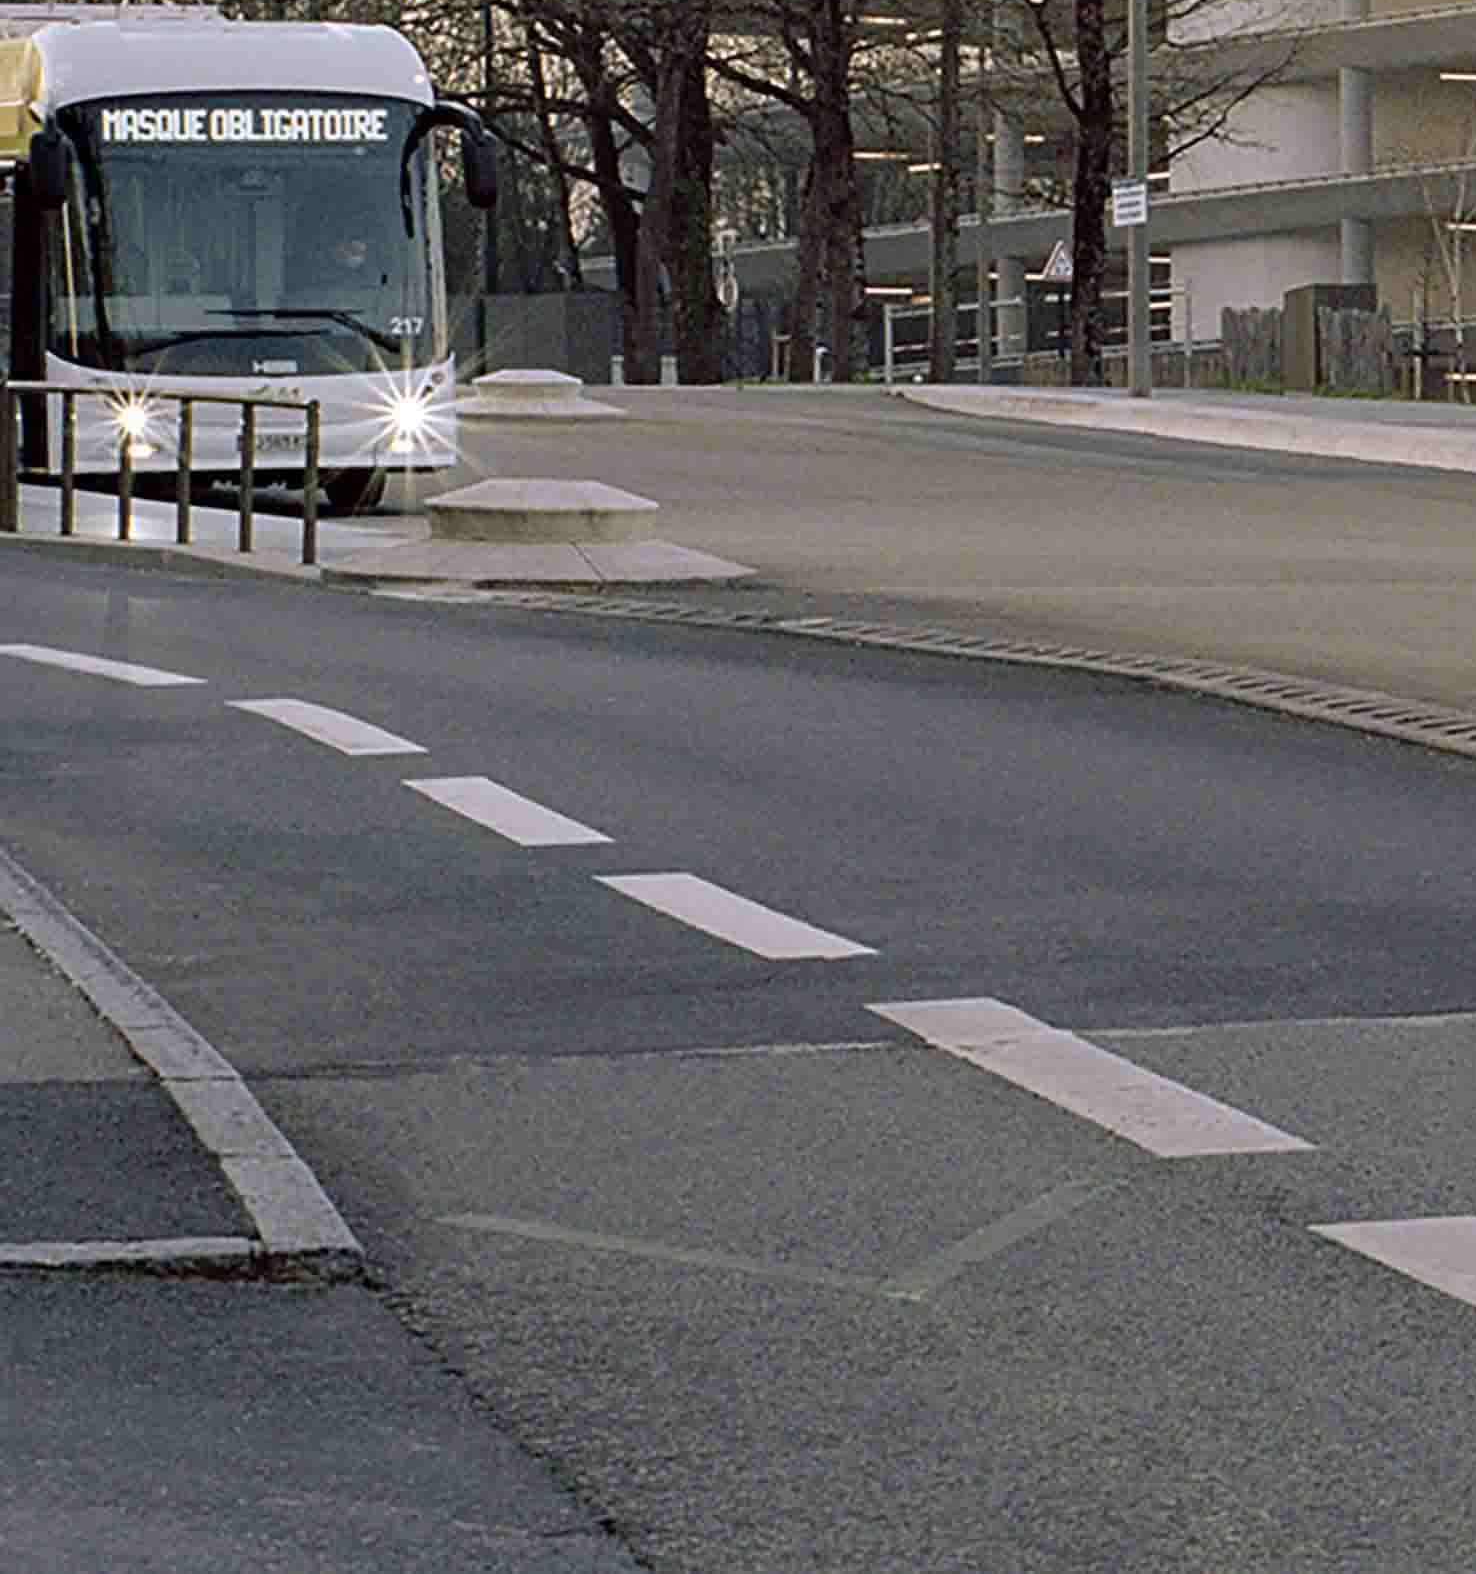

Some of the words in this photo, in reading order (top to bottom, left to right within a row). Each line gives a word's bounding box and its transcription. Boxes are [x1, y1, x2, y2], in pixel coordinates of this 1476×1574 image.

[102, 109, 206, 141] MASQUE
[211, 109, 387, 141] OBLIGATOIRE
[391, 317, 424, 336] 217
